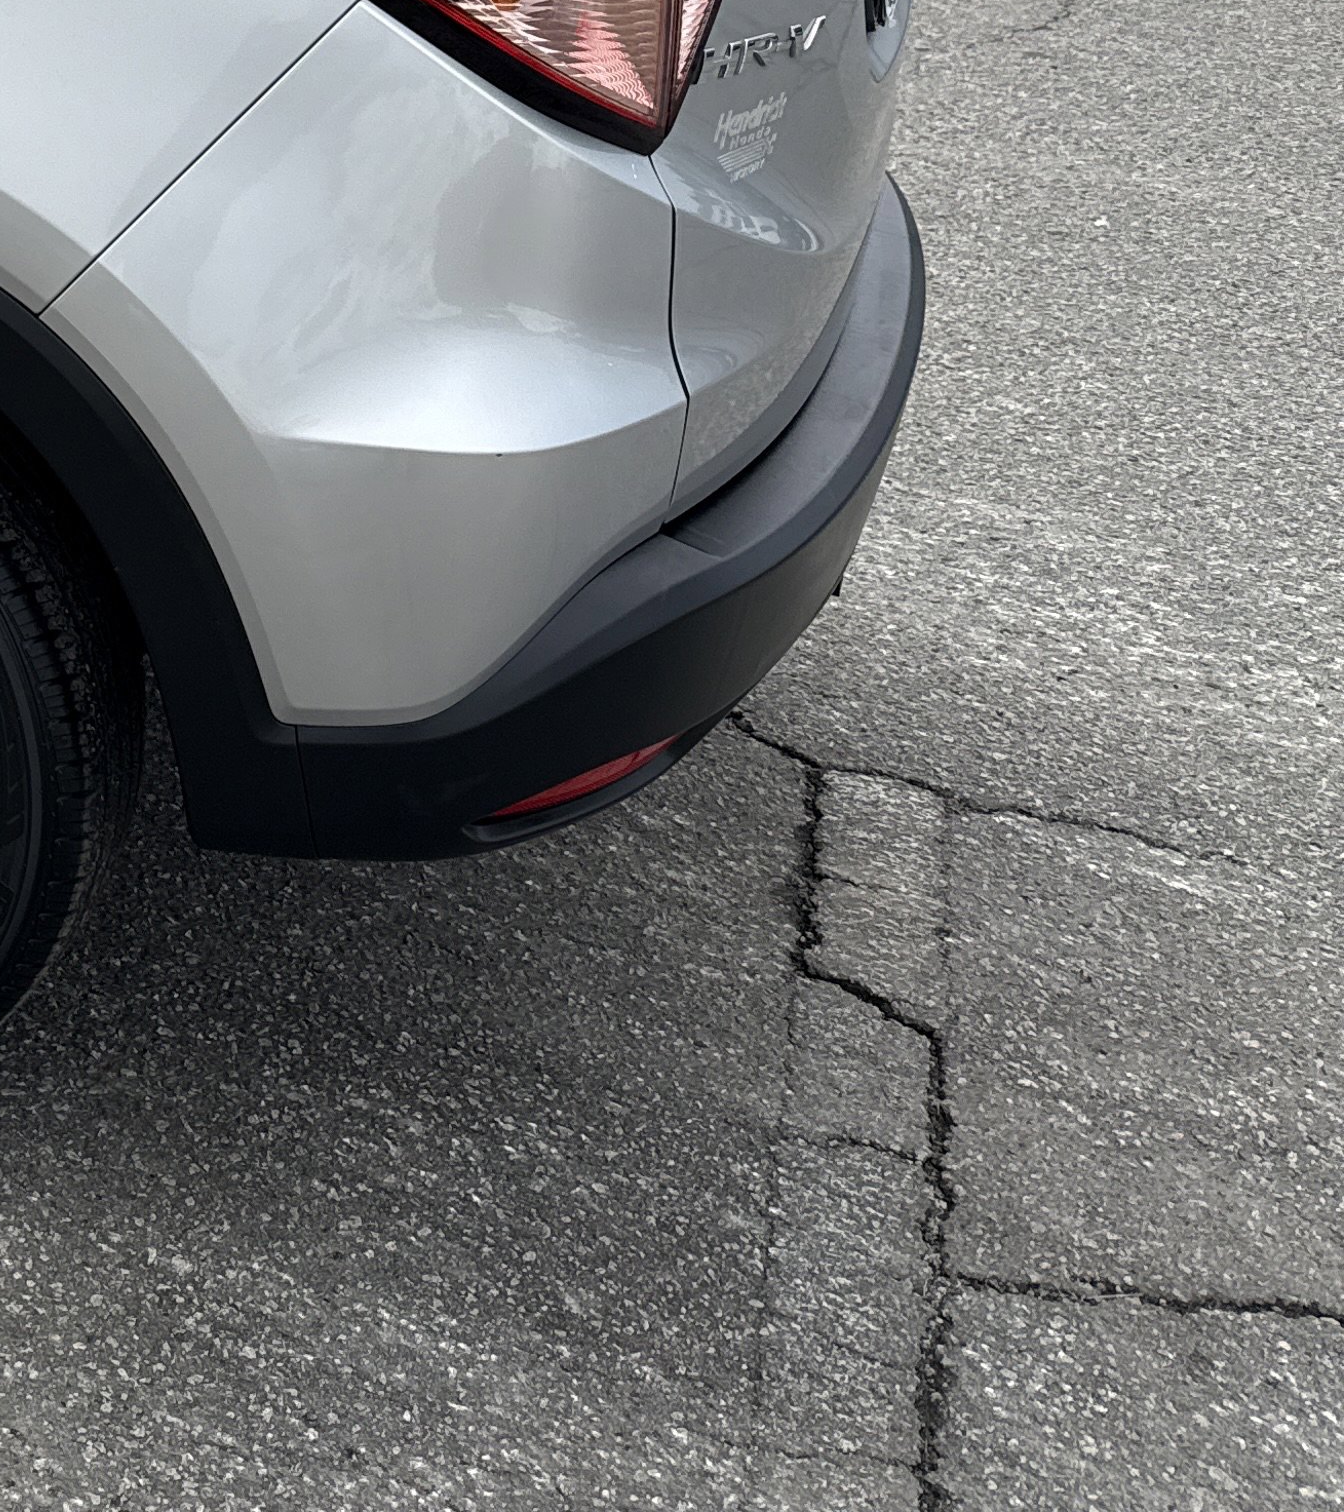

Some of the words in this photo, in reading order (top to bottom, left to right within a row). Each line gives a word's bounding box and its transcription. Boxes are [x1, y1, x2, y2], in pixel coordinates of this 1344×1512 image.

[703, 15, 826, 79] HR-V
[713, 91, 787, 150] Hendrick
[729, 126, 771, 151] Honda
